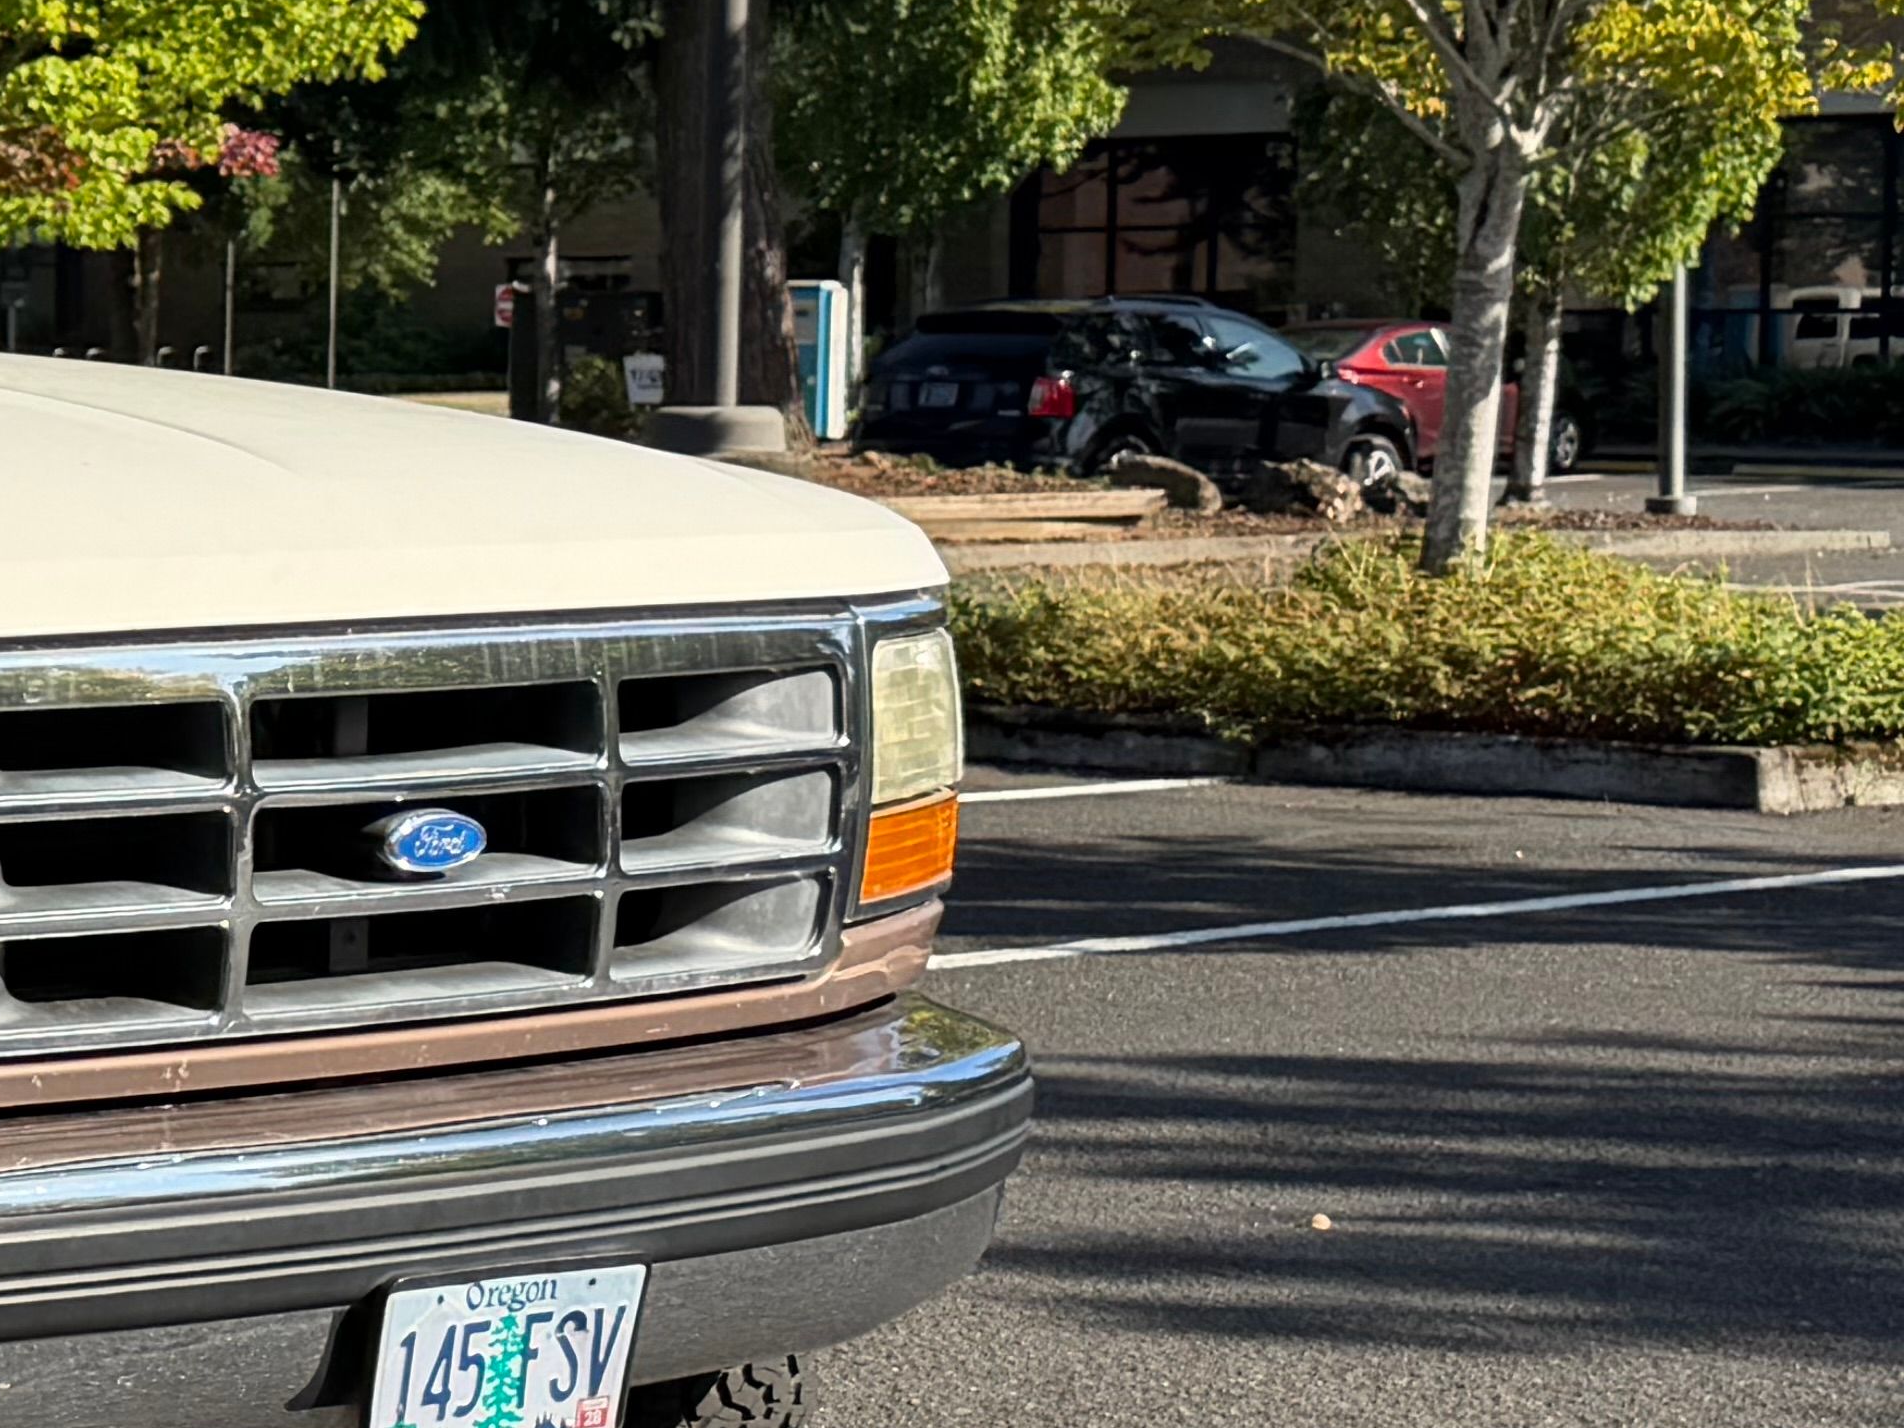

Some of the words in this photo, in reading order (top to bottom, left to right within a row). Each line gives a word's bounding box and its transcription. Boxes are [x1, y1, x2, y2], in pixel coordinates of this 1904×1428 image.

[414, 824, 467, 857] Ford
[465, 1278, 558, 1312] Oregon
[399, 1321, 492, 1425] 145
